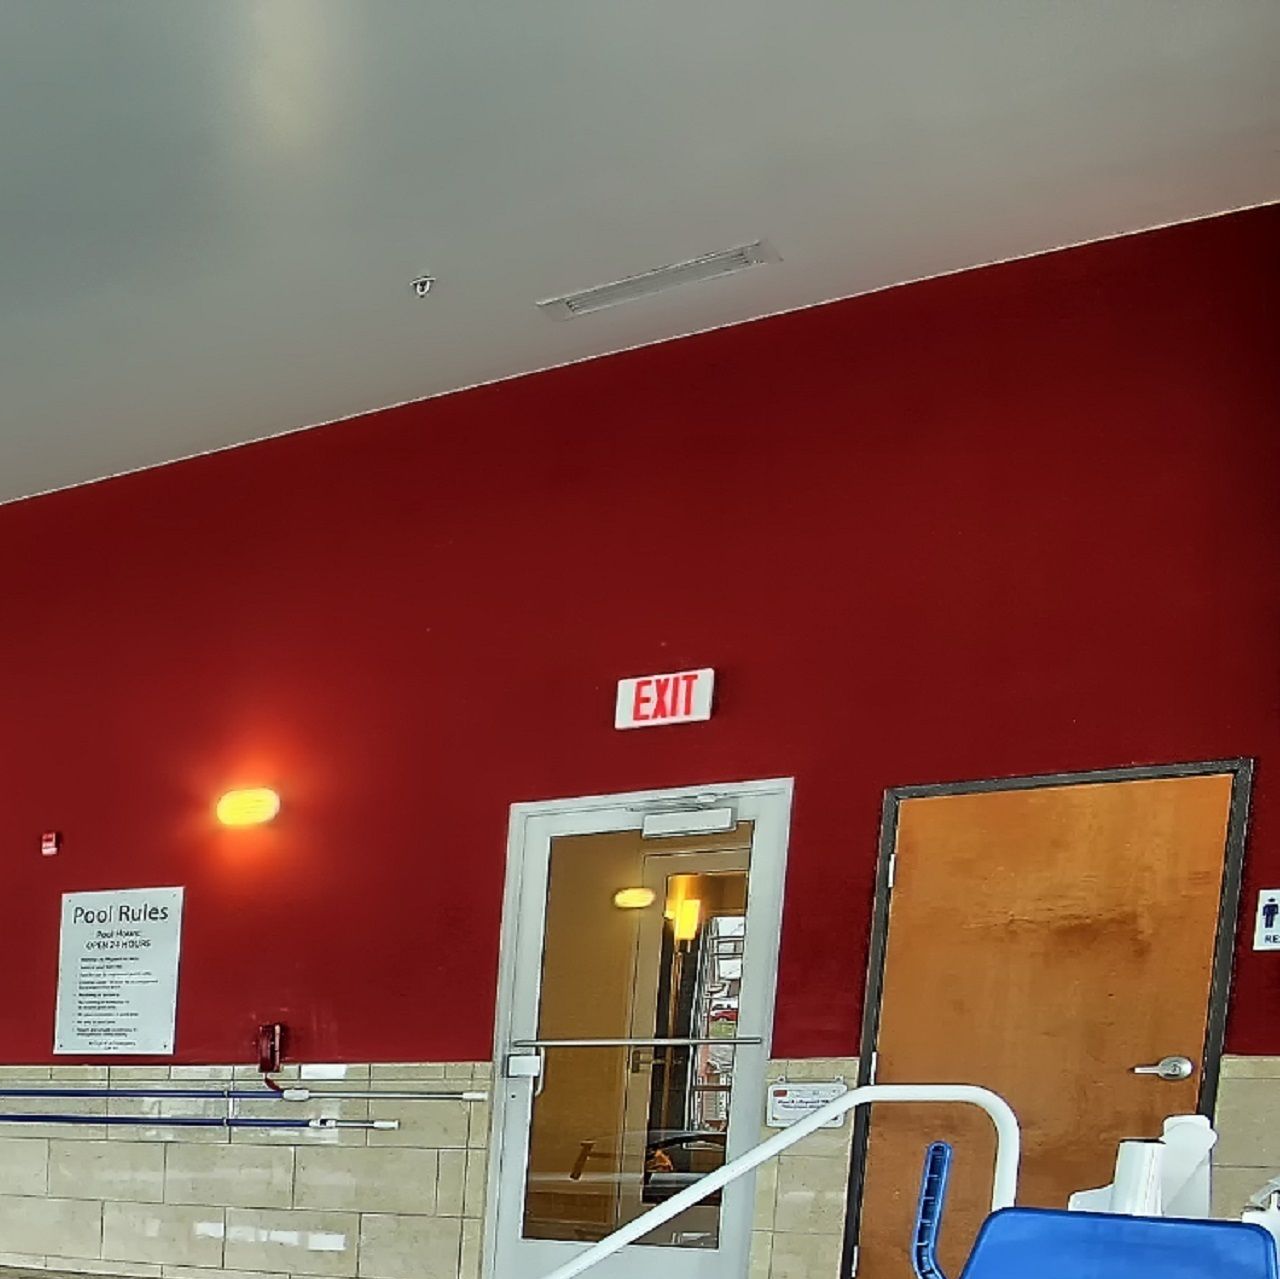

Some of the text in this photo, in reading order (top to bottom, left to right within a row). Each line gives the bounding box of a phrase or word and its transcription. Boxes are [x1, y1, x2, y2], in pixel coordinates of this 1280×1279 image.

[633, 674, 698, 720] EXIT
[73, 903, 169, 924] Pool Rules
